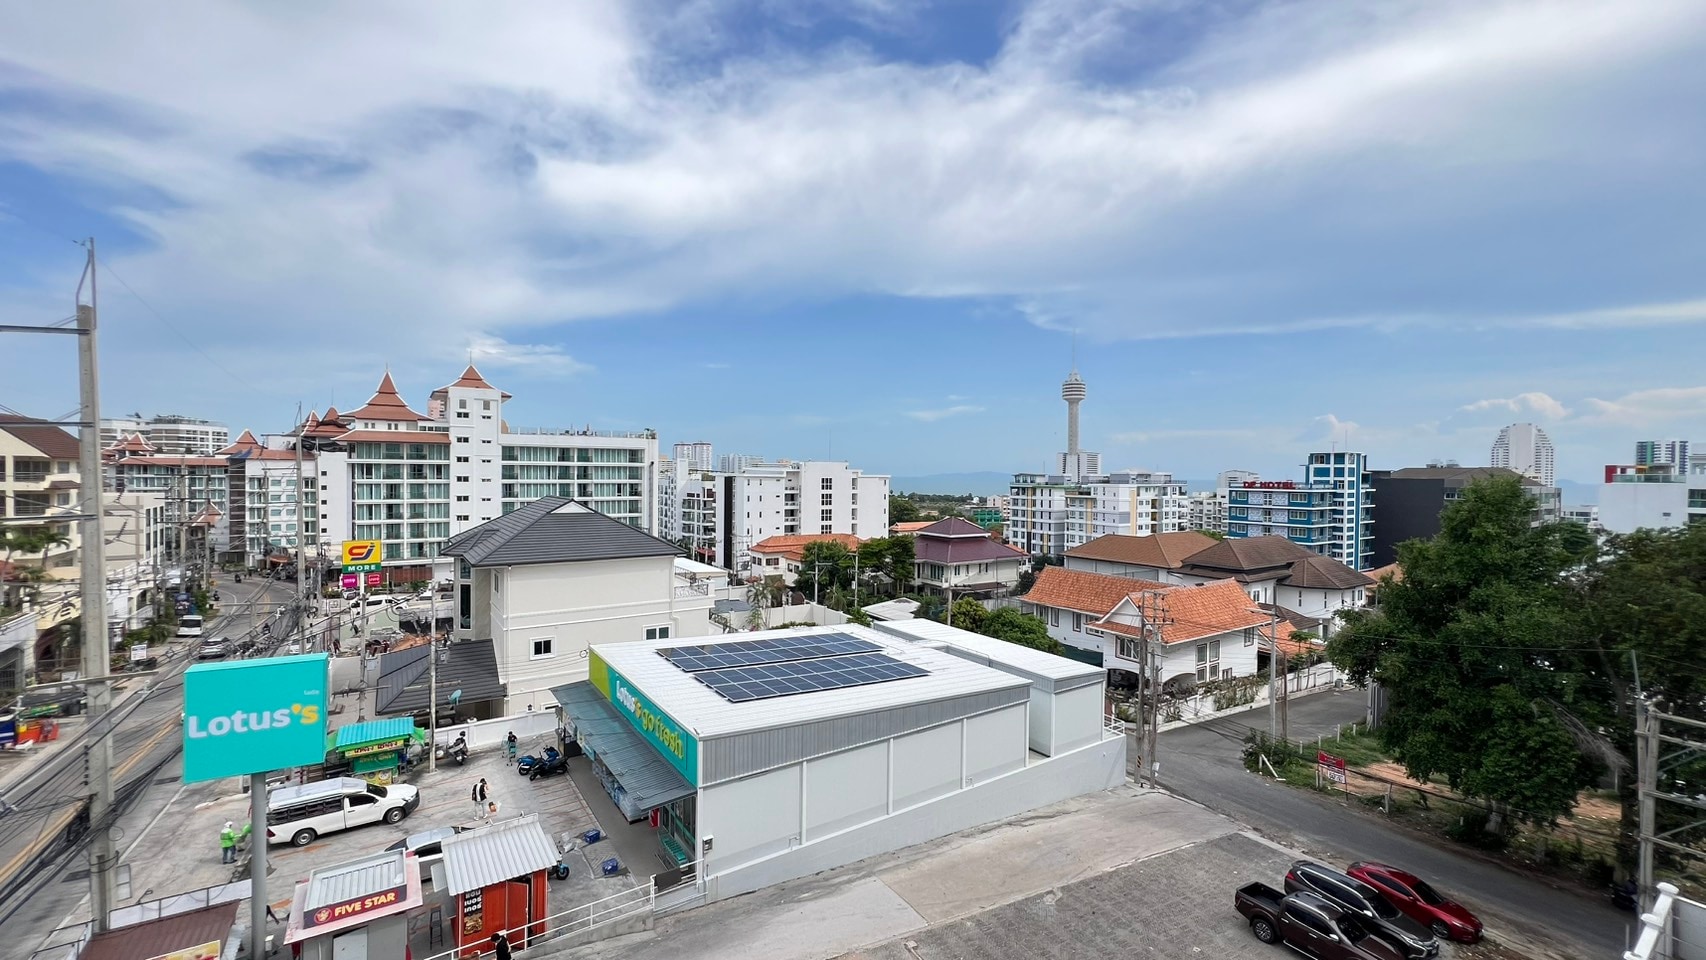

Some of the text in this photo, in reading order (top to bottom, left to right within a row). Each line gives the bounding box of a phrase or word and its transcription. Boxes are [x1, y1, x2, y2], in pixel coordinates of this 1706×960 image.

[1260, 481, 1296, 489] HOTEL
[188, 703, 319, 738] Lotus's
[334, 892, 396, 916] FIVE STAR
